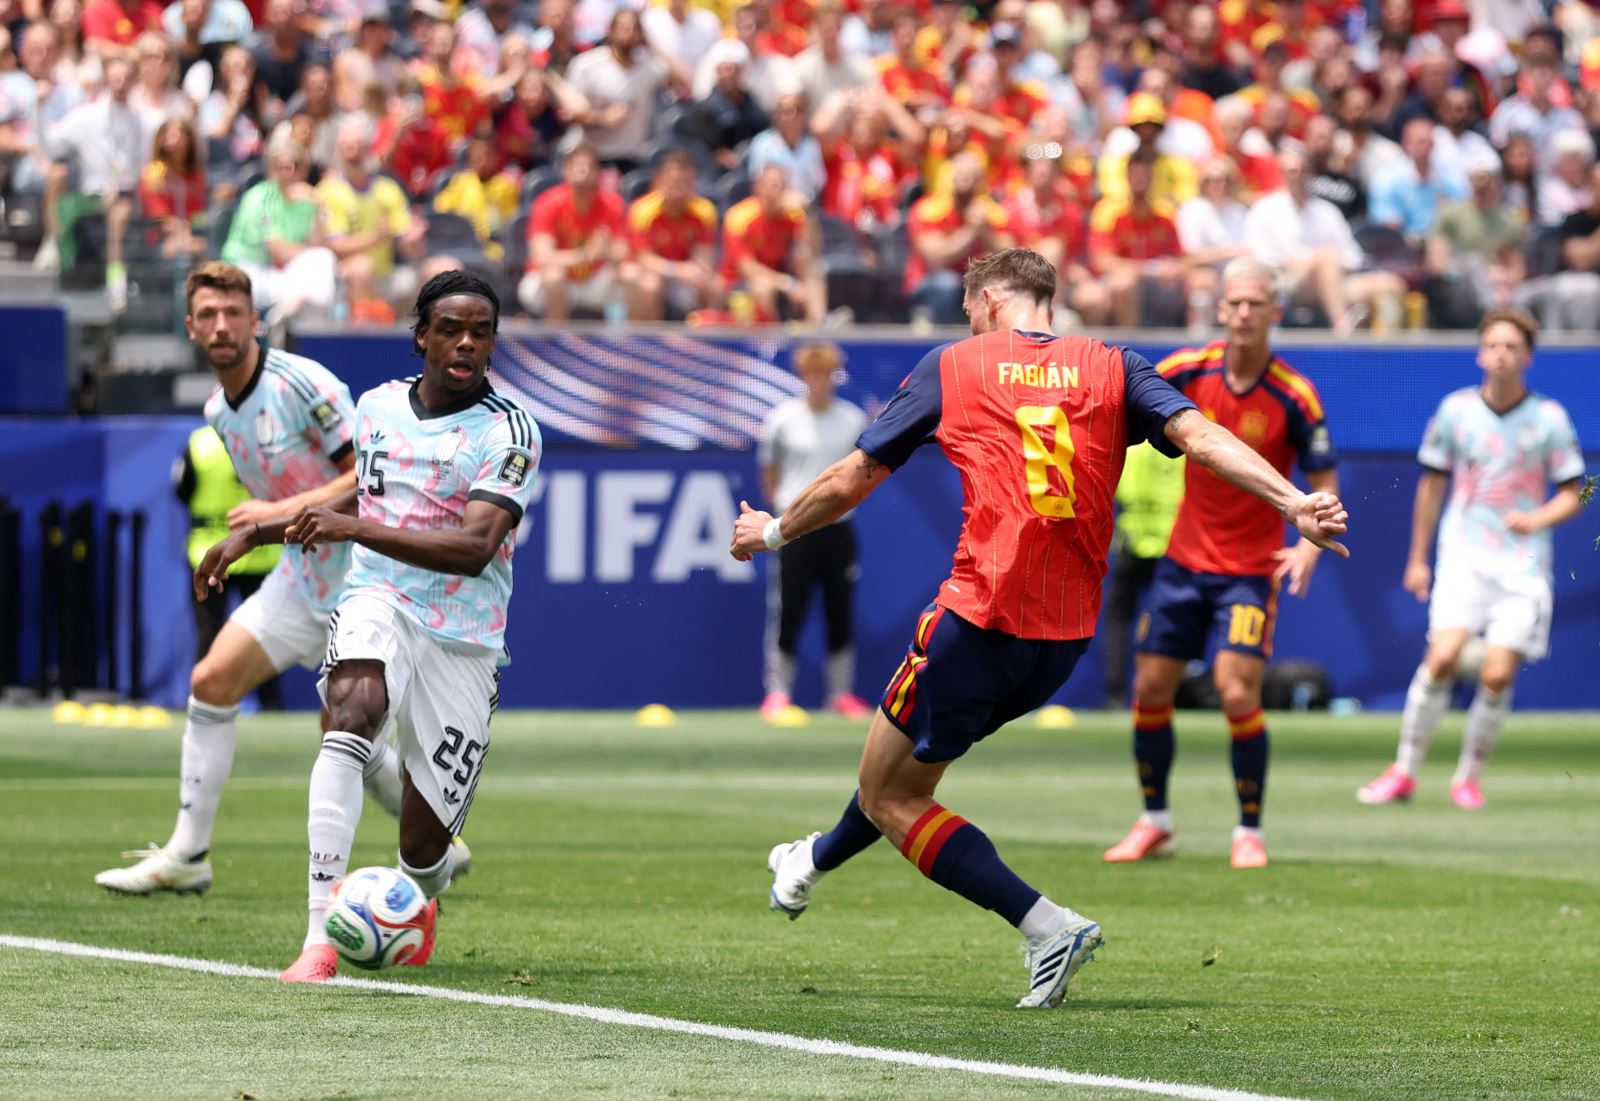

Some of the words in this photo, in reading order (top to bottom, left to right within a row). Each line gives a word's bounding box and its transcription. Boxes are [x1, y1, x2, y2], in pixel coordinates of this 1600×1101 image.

[997, 361, 1079, 388] FABIÁN
[1014, 405, 1077, 518] 8
[514, 471, 757, 584] IFA
[1228, 604, 1266, 647] 10
[432, 725, 482, 787] 25
